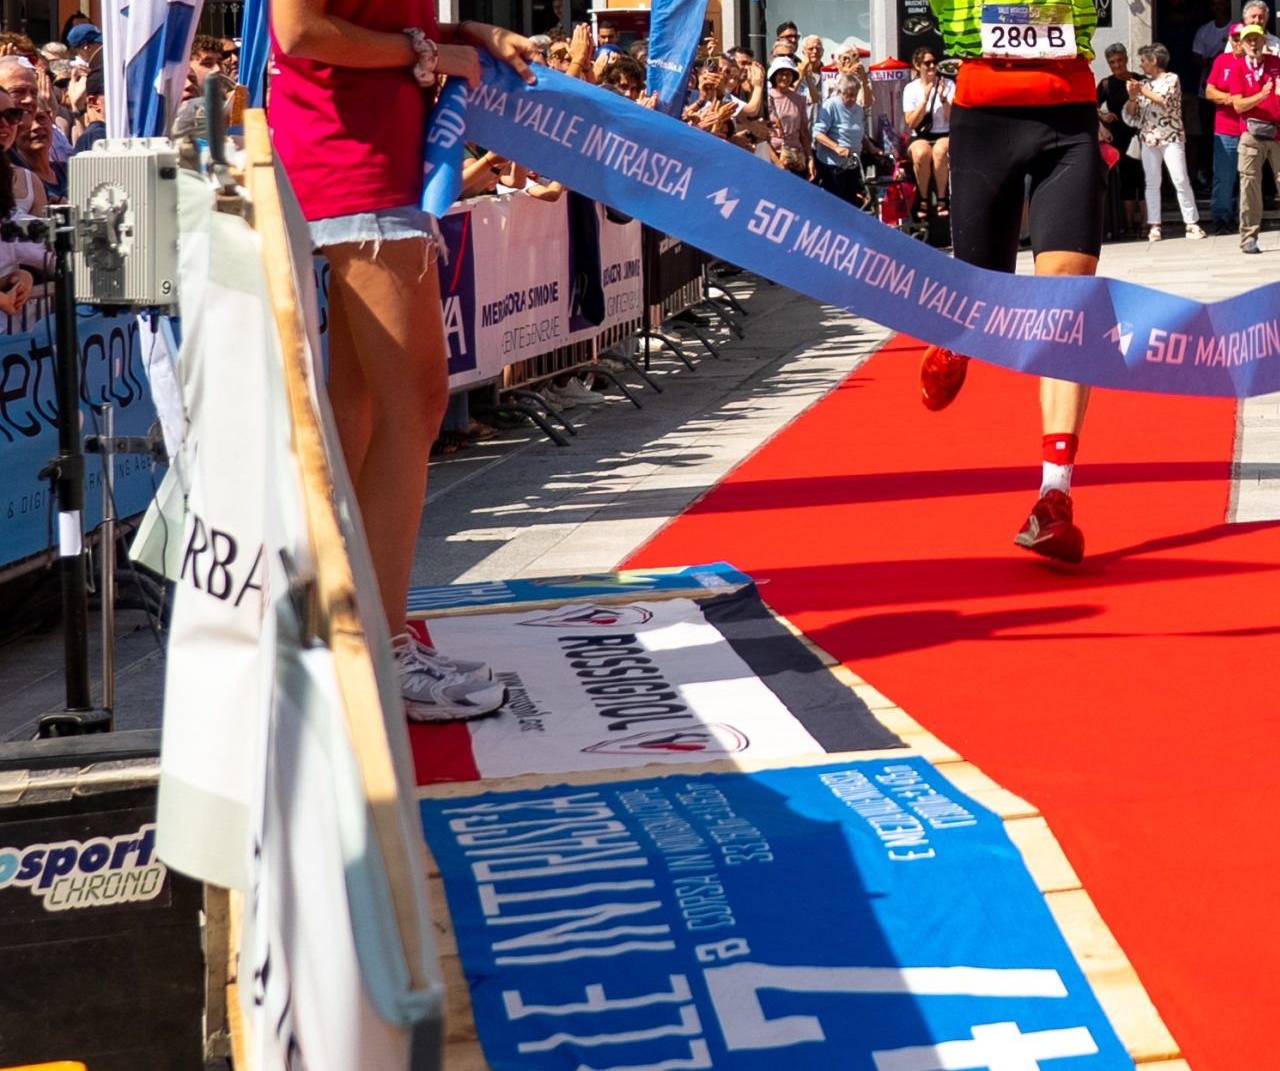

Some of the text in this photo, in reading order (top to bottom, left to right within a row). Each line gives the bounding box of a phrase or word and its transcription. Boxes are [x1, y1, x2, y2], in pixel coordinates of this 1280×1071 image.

[991, 26, 1067, 49] 280 B
[513, 98, 585, 149] VALLE
[581, 123, 694, 201] INTRASCA
[161, 280, 172, 295] 9
[793, 219, 913, 299] MARATONA
[917, 276, 987, 330] VALLE
[984, 304, 1086, 347] INTRASCA
[557, 633, 694, 731] ROSSIGNOL
[50, 868, 162, 906] CHRONO
[441, 791, 677, 966] INTRASCA
[664, 852, 716, 872] IN
[672, 873, 737, 931] CORSA
